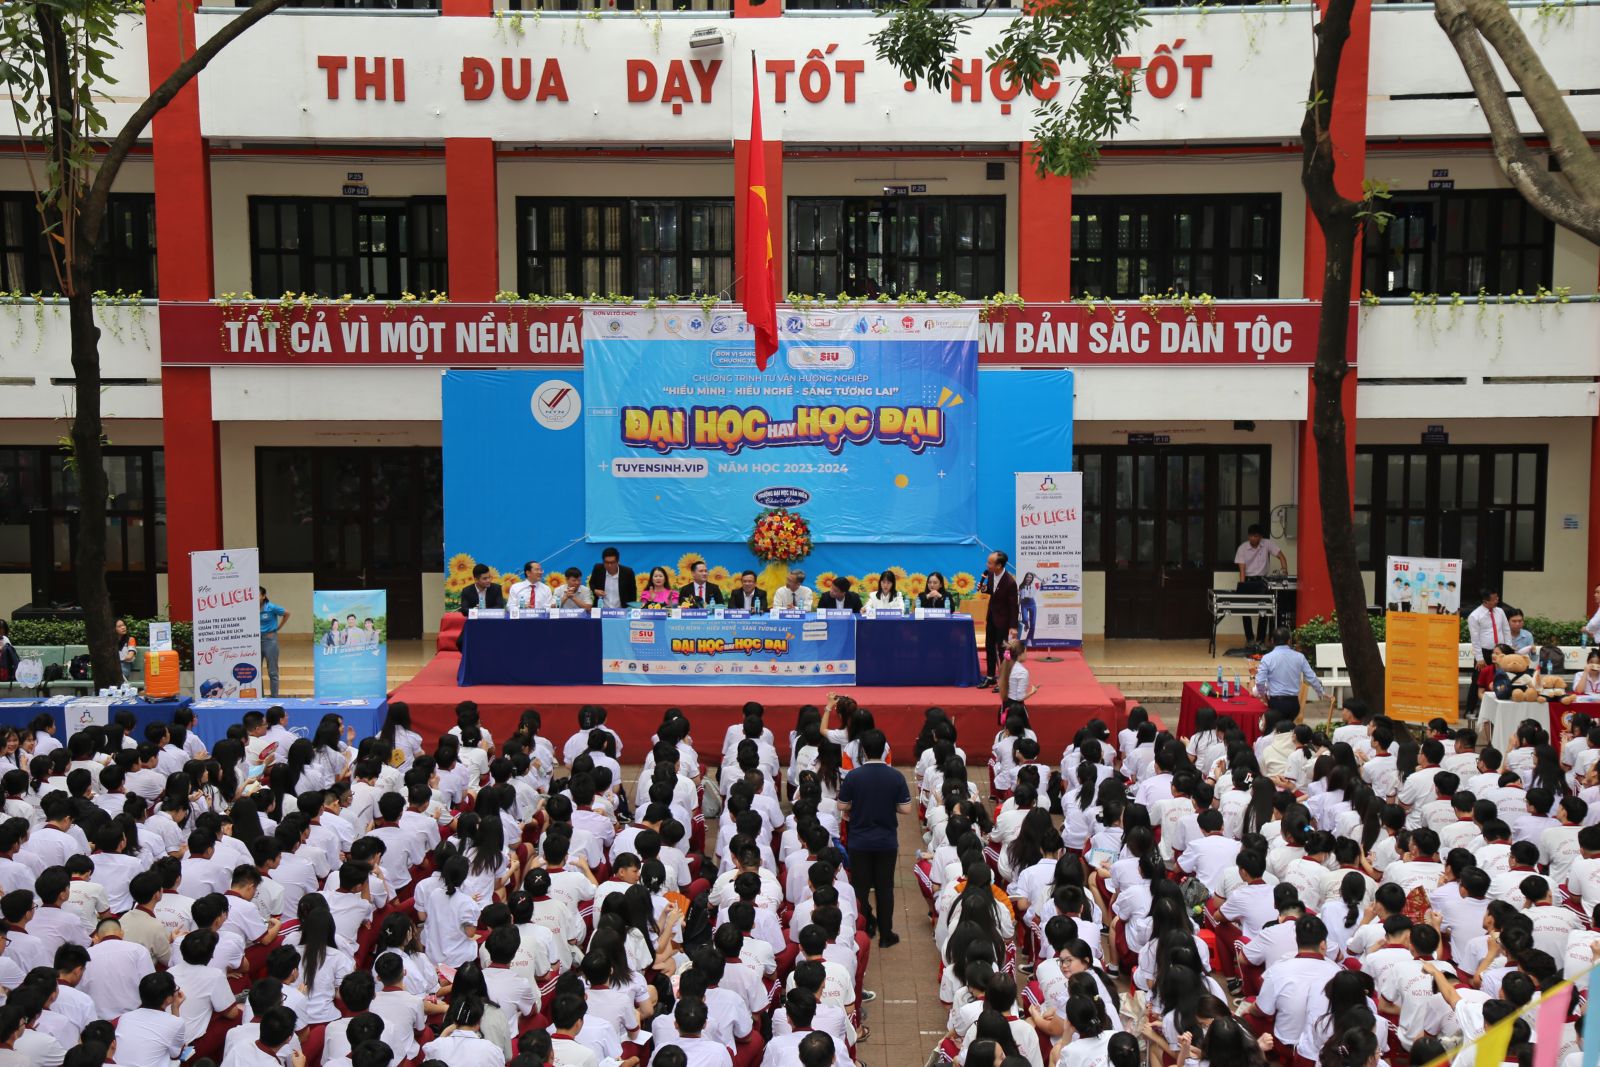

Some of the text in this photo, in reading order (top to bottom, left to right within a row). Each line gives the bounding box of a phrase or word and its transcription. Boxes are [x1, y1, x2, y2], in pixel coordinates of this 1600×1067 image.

[317, 55, 406, 102] THI
[461, 56, 569, 103] ĐUA
[626, 59, 724, 115] DẠY
[765, 43, 865, 104] TỐT
[225, 311, 584, 360] TẤT CẢ VÌ MỘT NỀN GIÁ
[1015, 311, 1079, 353] BẢN
[1088, 310, 1150, 354] SẮC
[1160, 315, 1224, 353] DÂN
[1233, 314, 1293, 360] TỘC
[820, 352, 839, 361] SIU
[692, 374, 733, 382] CHƯƠNG
[735, 373, 762, 382] TRÌNH
[834, 373, 869, 383] NGHIỆP
[696, 386, 725, 395] MÌNH
[763, 385, 793, 395] NGHỀ
[802, 385, 832, 395] SÁNG
[834, 387, 872, 396] TƯƠNG
[625, 406, 941, 450] ĐẠI HỌC HAY HỌC ĐẠI
[615, 463, 705, 473] TUYENSINH.VIP
[718, 461, 848, 475] NĂM HỌC 2023-2024
[1020, 508, 1077, 528] DU LỊCH
[1393, 563, 1409, 571] SIU
[197, 586, 254, 612] DU LỊCH
[671, 639, 695, 655] ĐẠI
[697, 639, 724, 655] HỌC
[734, 638, 762, 654] HỌC
[764, 639, 788, 655] ĐẠI
